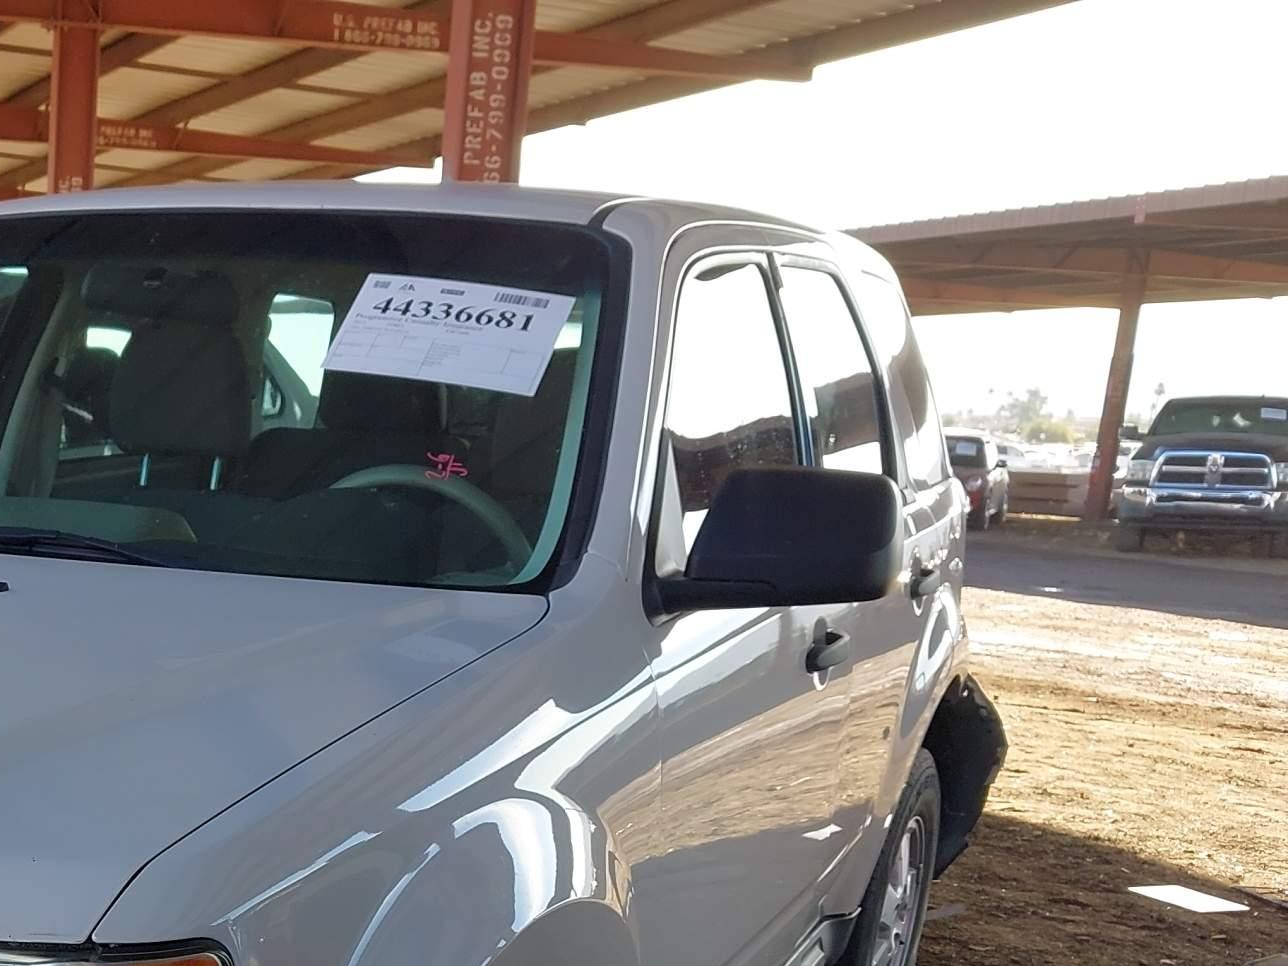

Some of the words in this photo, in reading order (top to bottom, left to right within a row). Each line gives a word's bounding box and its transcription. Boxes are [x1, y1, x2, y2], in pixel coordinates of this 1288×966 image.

[472, 12, 494, 58] INC.
[464, 71, 489, 166] PREFAB
[372, 297, 535, 332] 44336681
